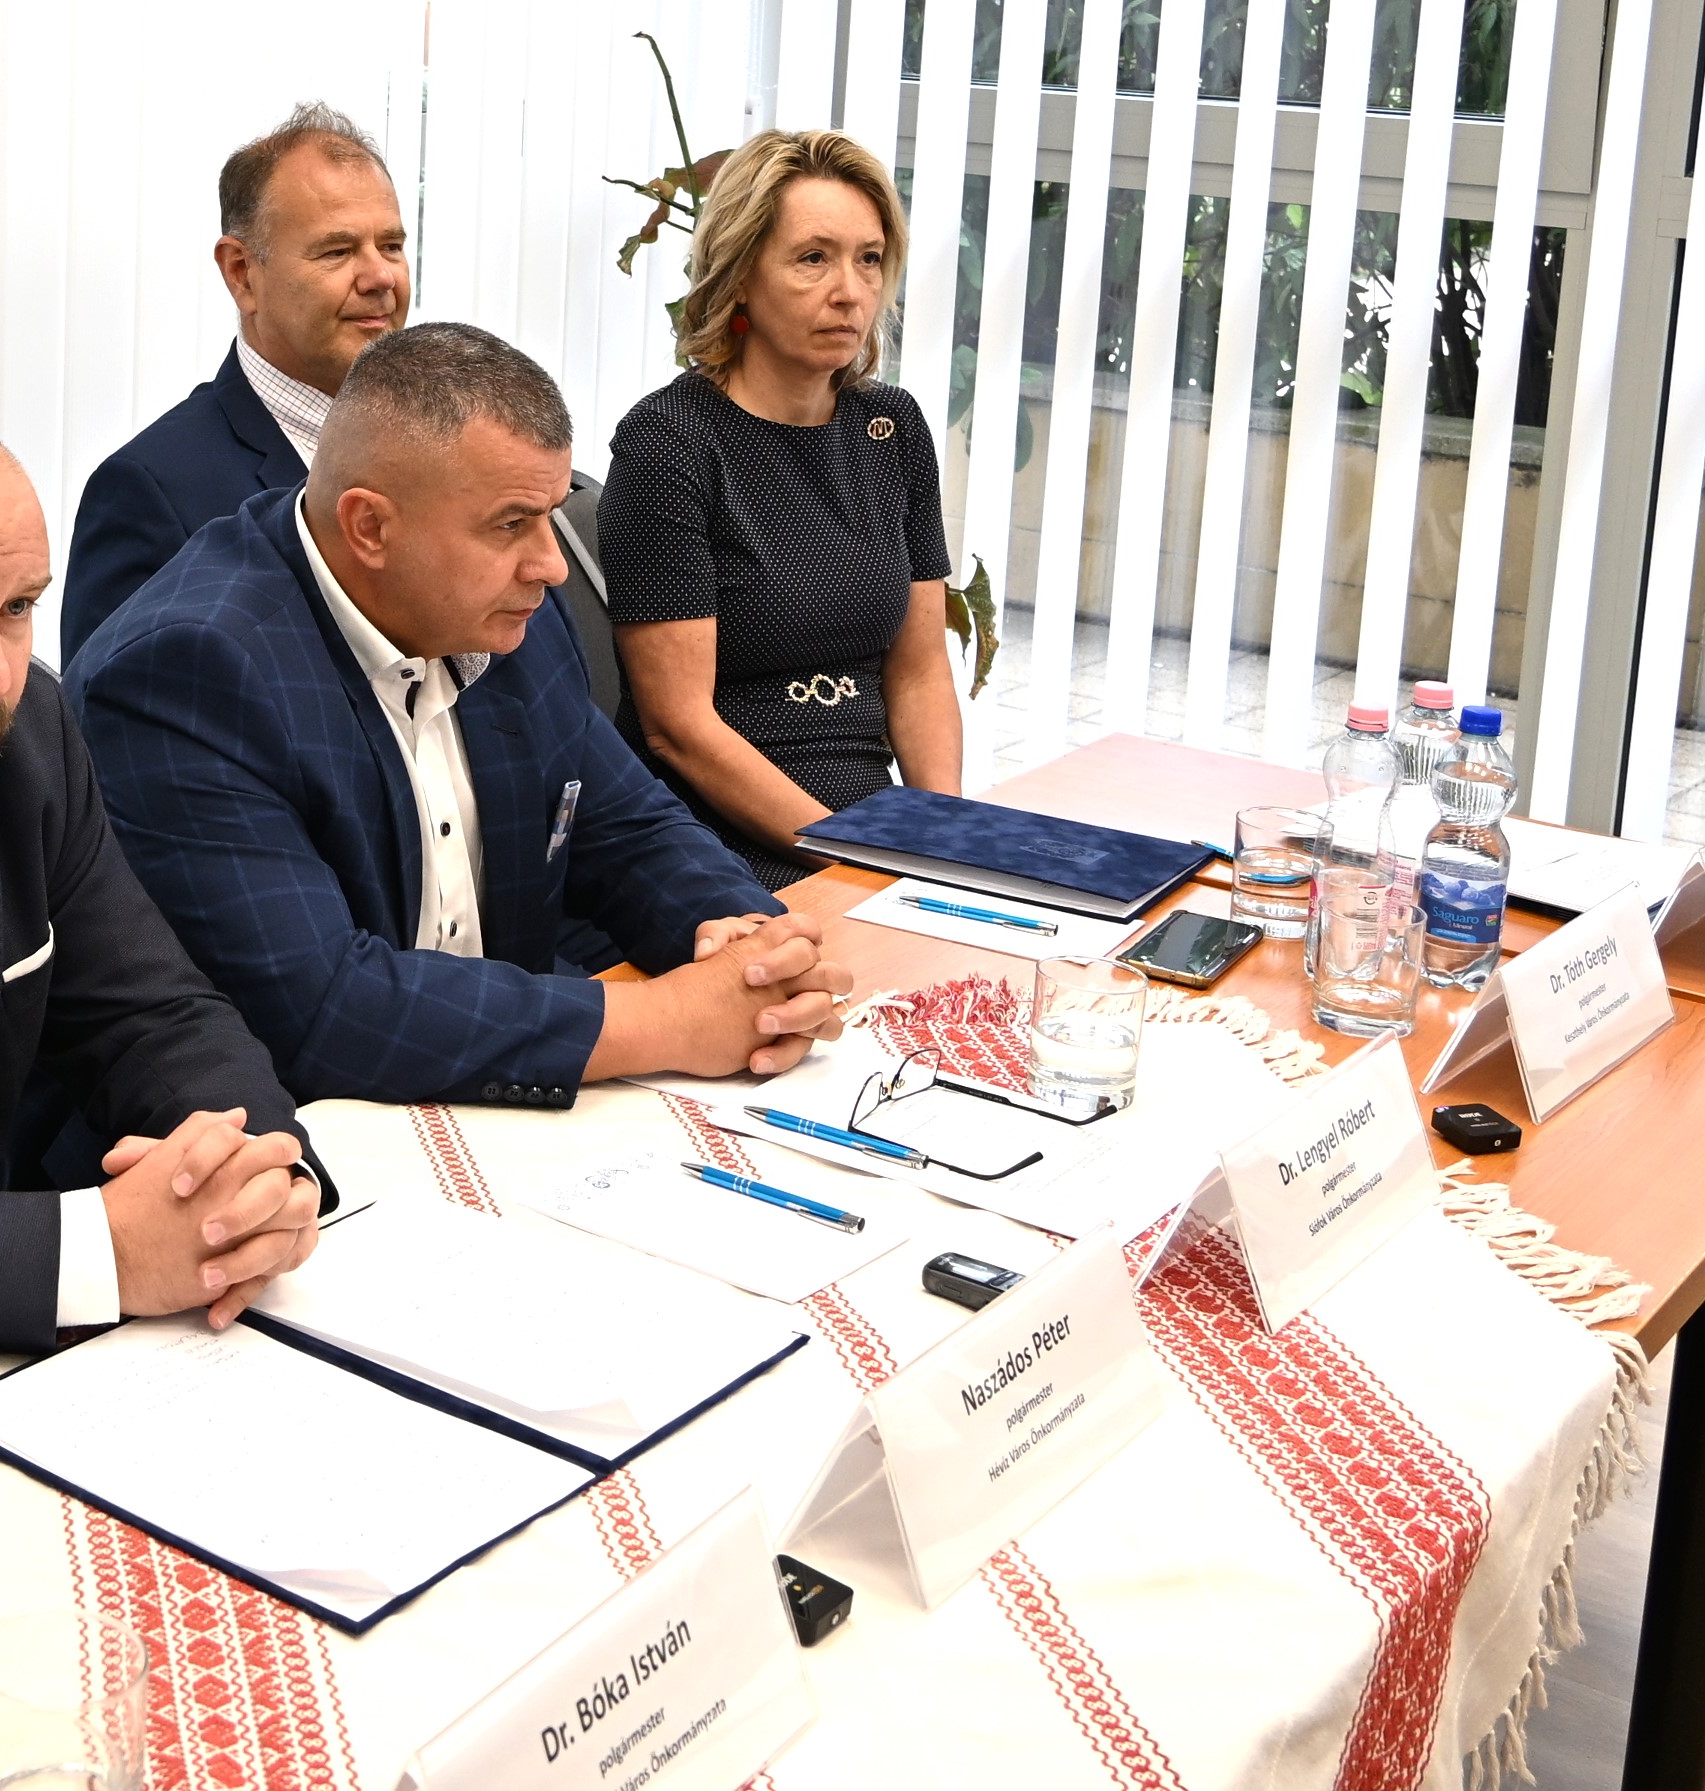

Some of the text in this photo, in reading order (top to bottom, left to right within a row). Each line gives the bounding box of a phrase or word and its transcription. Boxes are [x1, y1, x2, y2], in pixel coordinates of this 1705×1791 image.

[1432, 906, 1480, 924] Saguaro
[1549, 935, 1618, 994] Dr. Tóth Gergely
[1278, 1099, 1375, 1186] Dr. Lengyel Róbert
[1308, 1171, 1383, 1237] Siófok Város Önkormányzata
[1321, 1161, 1357, 1198] polgármester
[961, 1314, 1071, 1416] Naszádos Péter
[988, 1392, 1086, 1482] Hévíz Város Önkormányzata
[1006, 1382, 1054, 1432] polgármester
[541, 1619, 691, 1763] Dr. Bóka István
[599, 1706, 666, 1779] polgármester
[650, 1698, 727, 1773] Önkormányzata
